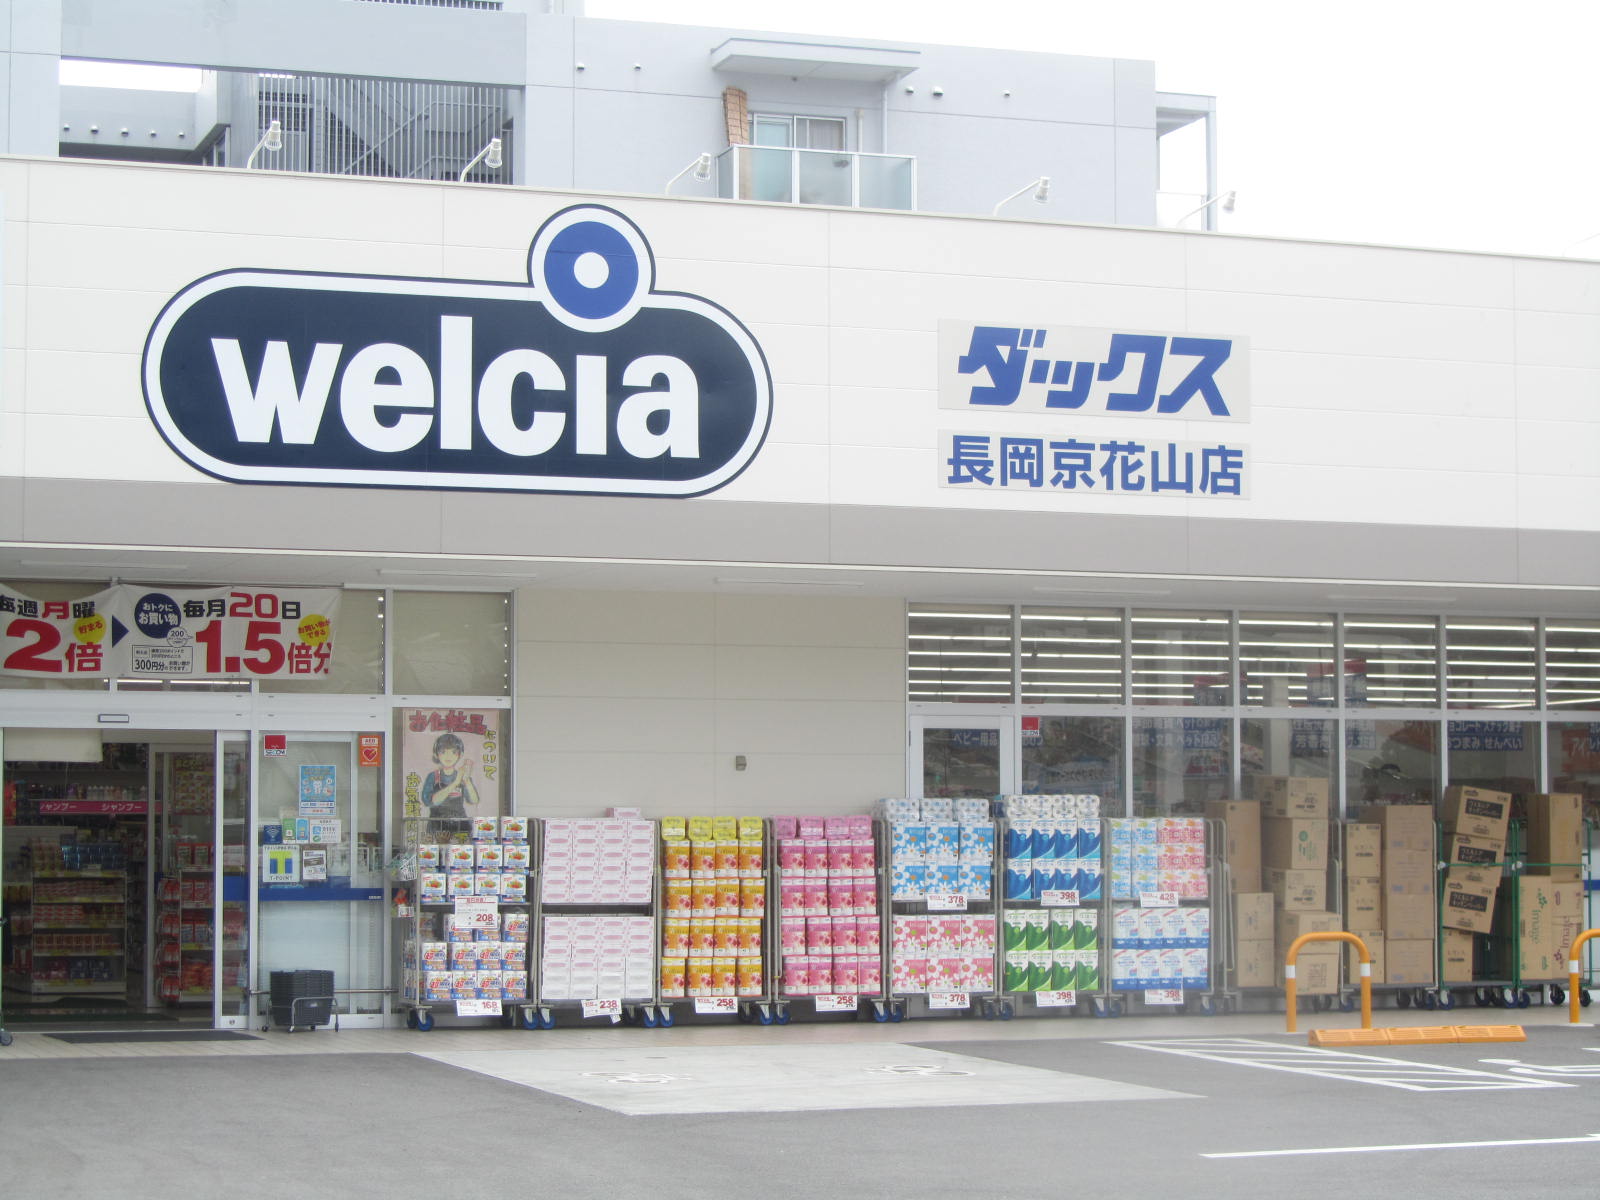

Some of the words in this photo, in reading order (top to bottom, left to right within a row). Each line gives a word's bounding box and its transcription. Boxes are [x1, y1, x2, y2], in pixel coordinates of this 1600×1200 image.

[958, 326, 1232, 416] ダックス
[211, 314, 700, 459] welcia
[947, 435, 1243, 496] 長岡京花山店
[184, 592, 301, 619] 毎月20日
[139, 613, 179, 625] お買い物
[4, 619, 103, 672] 2倍
[476, 914, 494, 922] 208
[600, 1001, 618, 1009] 238
[717, 998, 734, 1007] 258
[837, 996, 854, 1004] 258
